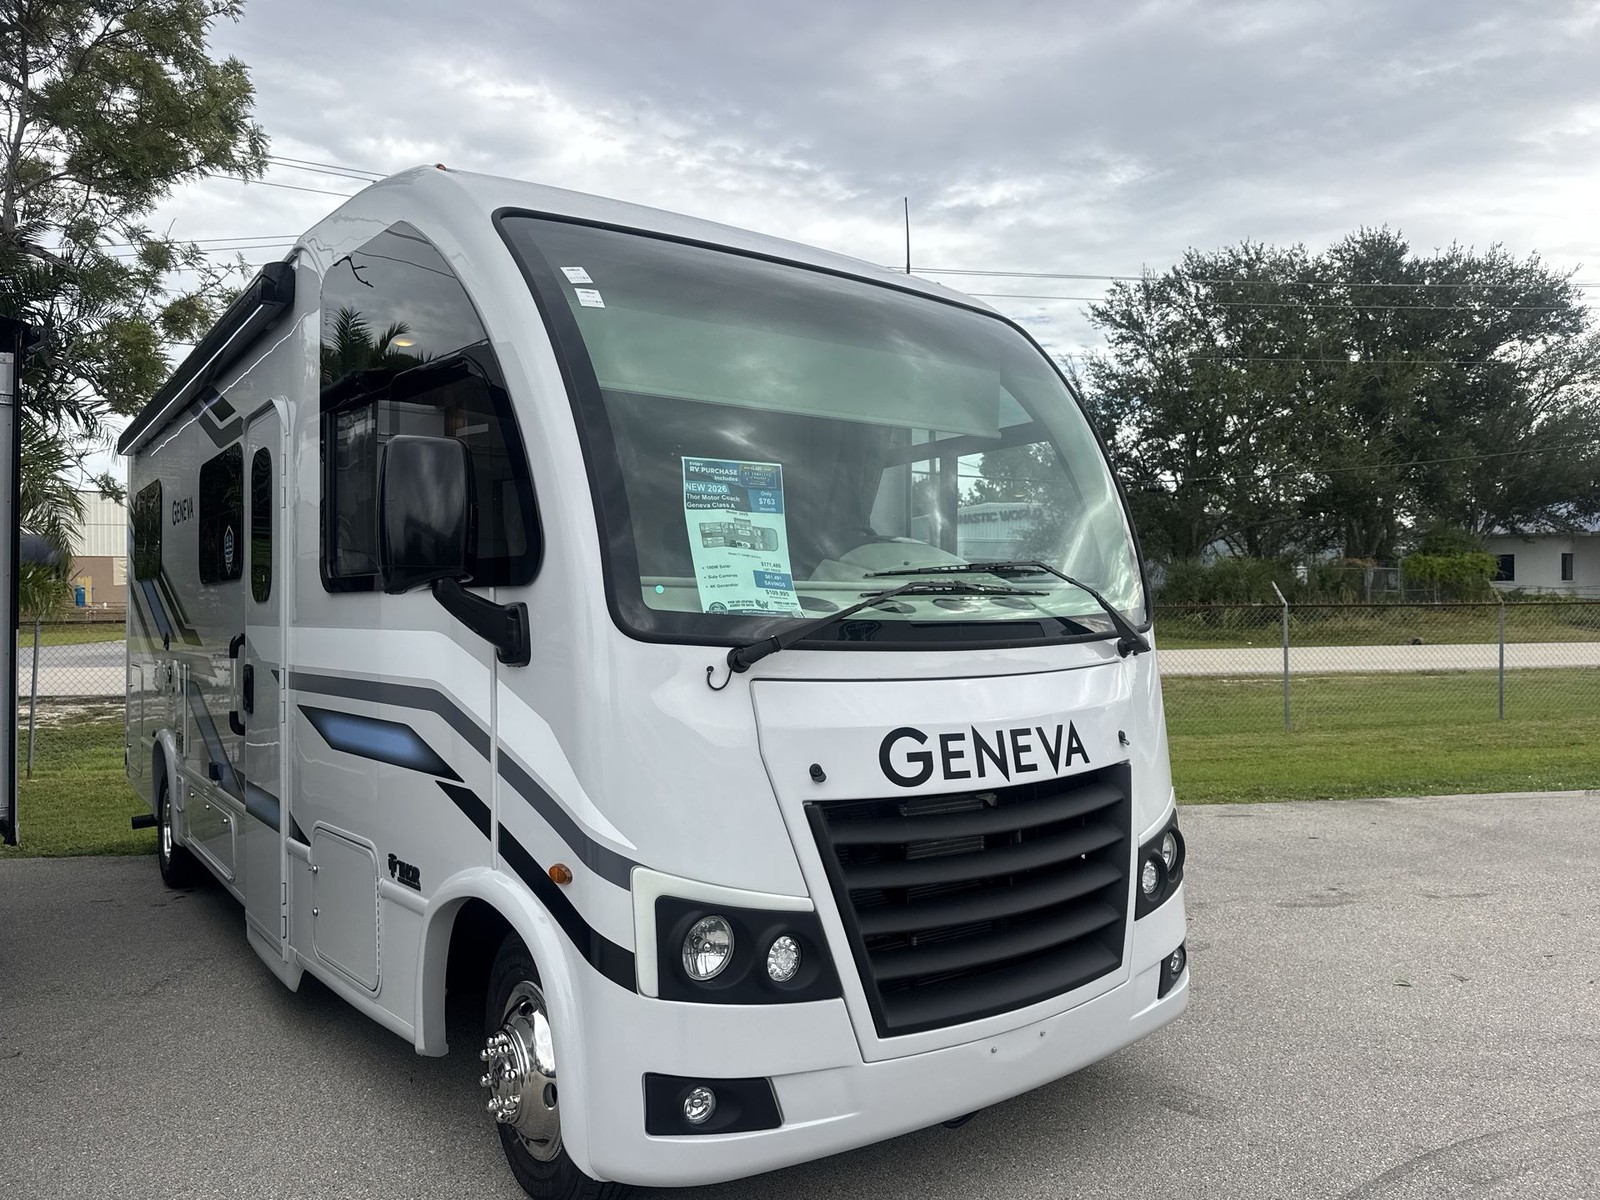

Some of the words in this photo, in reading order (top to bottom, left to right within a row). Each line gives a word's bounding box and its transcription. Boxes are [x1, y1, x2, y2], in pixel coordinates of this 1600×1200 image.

[701, 467, 738, 476] PURCHASE
[686, 482, 706, 492] NEW
[707, 484, 728, 493] 2026
[721, 494, 740, 503] Coach
[758, 497, 776, 505] $763
[879, 719, 1090, 788] GENEVA
